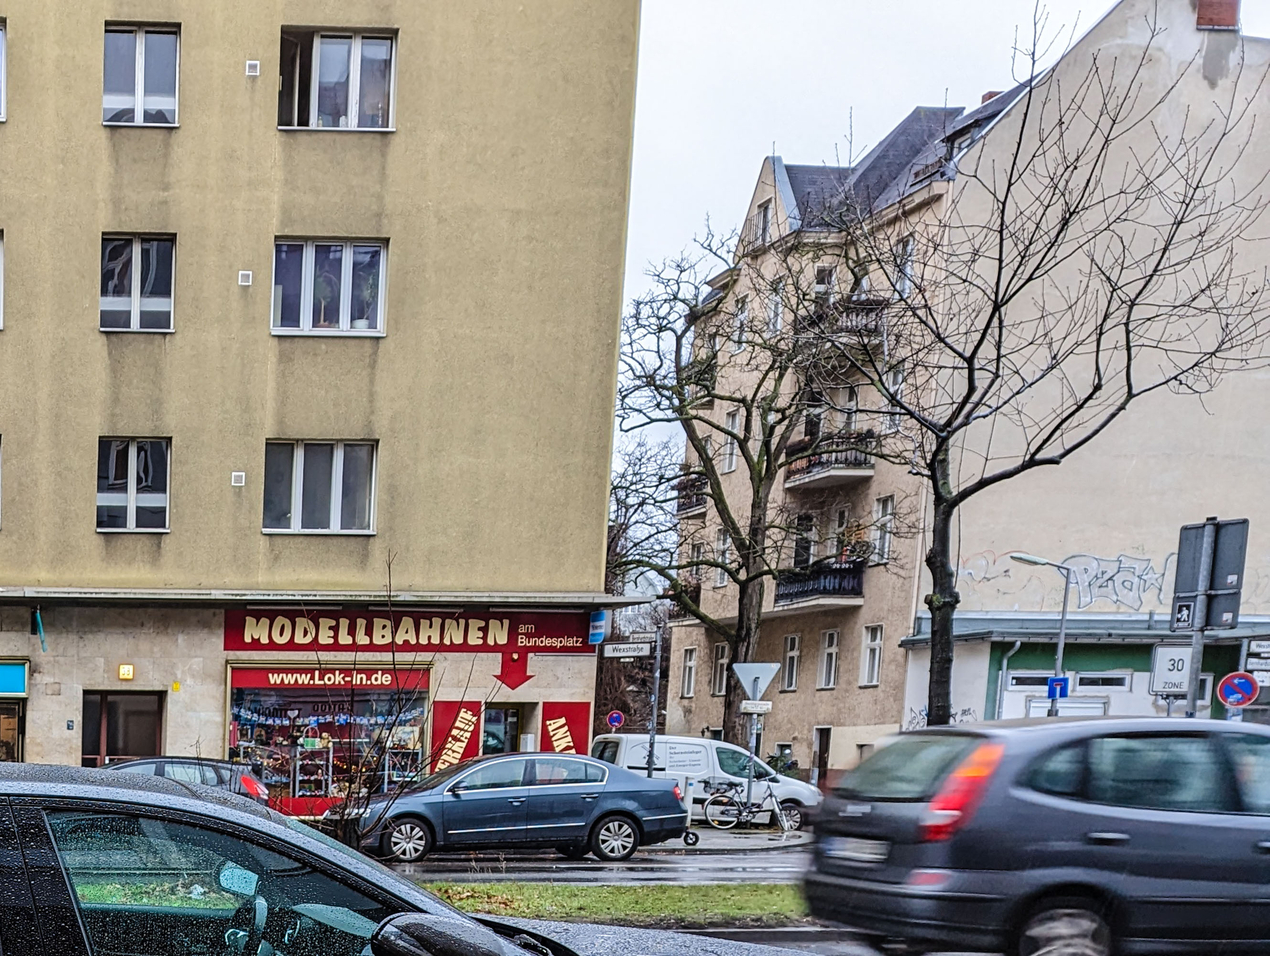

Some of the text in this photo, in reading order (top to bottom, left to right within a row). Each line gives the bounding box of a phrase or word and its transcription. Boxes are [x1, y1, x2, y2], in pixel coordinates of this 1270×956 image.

[243, 615, 510, 647] MODELLBAHNEN
[518, 624, 535, 633] am
[517, 635, 583, 648] Bundesplatz
[1167, 658, 1185, 672] 30
[267, 670, 392, 685] www.Lok-In.de
[1162, 681, 1185, 690] ZONE
[545, 716, 577, 755] ANK
